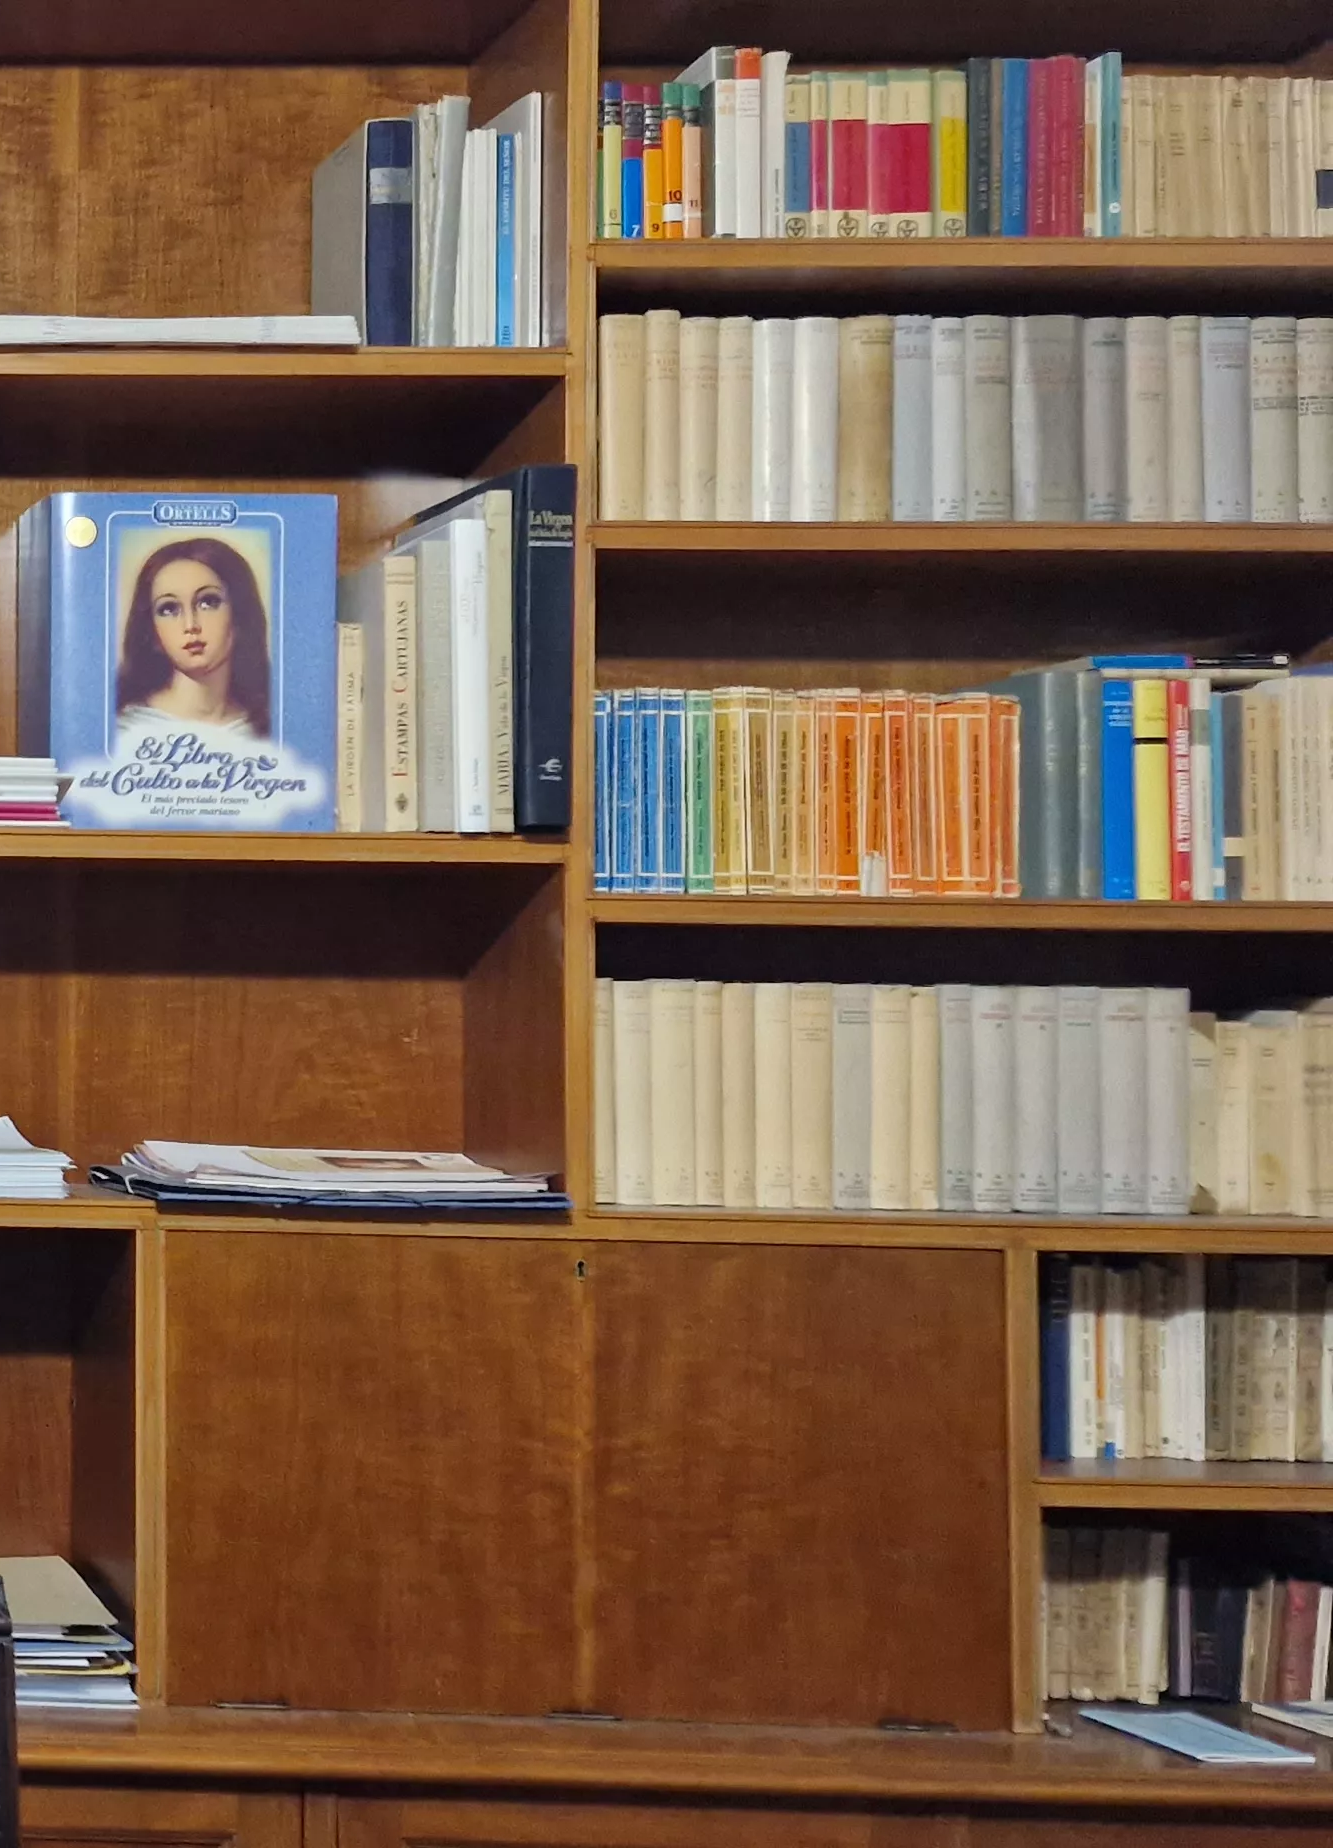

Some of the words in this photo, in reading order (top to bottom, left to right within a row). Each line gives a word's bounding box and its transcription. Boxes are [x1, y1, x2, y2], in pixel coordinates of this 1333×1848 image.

[668, 189, 683, 202] 10
[631, 224, 640, 237] 7
[651, 222, 660, 233] 9
[159, 504, 232, 521] ORTELLS
[390, 600, 408, 694] CARTUJANAS
[347, 718, 355, 730] DE
[391, 701, 408, 777] ESTAMPAS
[135, 736, 164, 761] El
[150, 733, 234, 772] Libro
[347, 736, 355, 777] VIRGEN
[79, 770, 111, 788] del
[111, 763, 183, 796] Culto
[217, 760, 307, 801] Virgen
[347, 783, 355, 797] LA
[141, 794, 152, 804] El
[154, 793, 175, 804] más
[175, 793, 218, 806] preciado
[219, 795, 249, 805] tesoro
[150, 805, 165, 815] del
[165, 806, 197, 818] fervor
[198, 807, 241, 816] mariano
